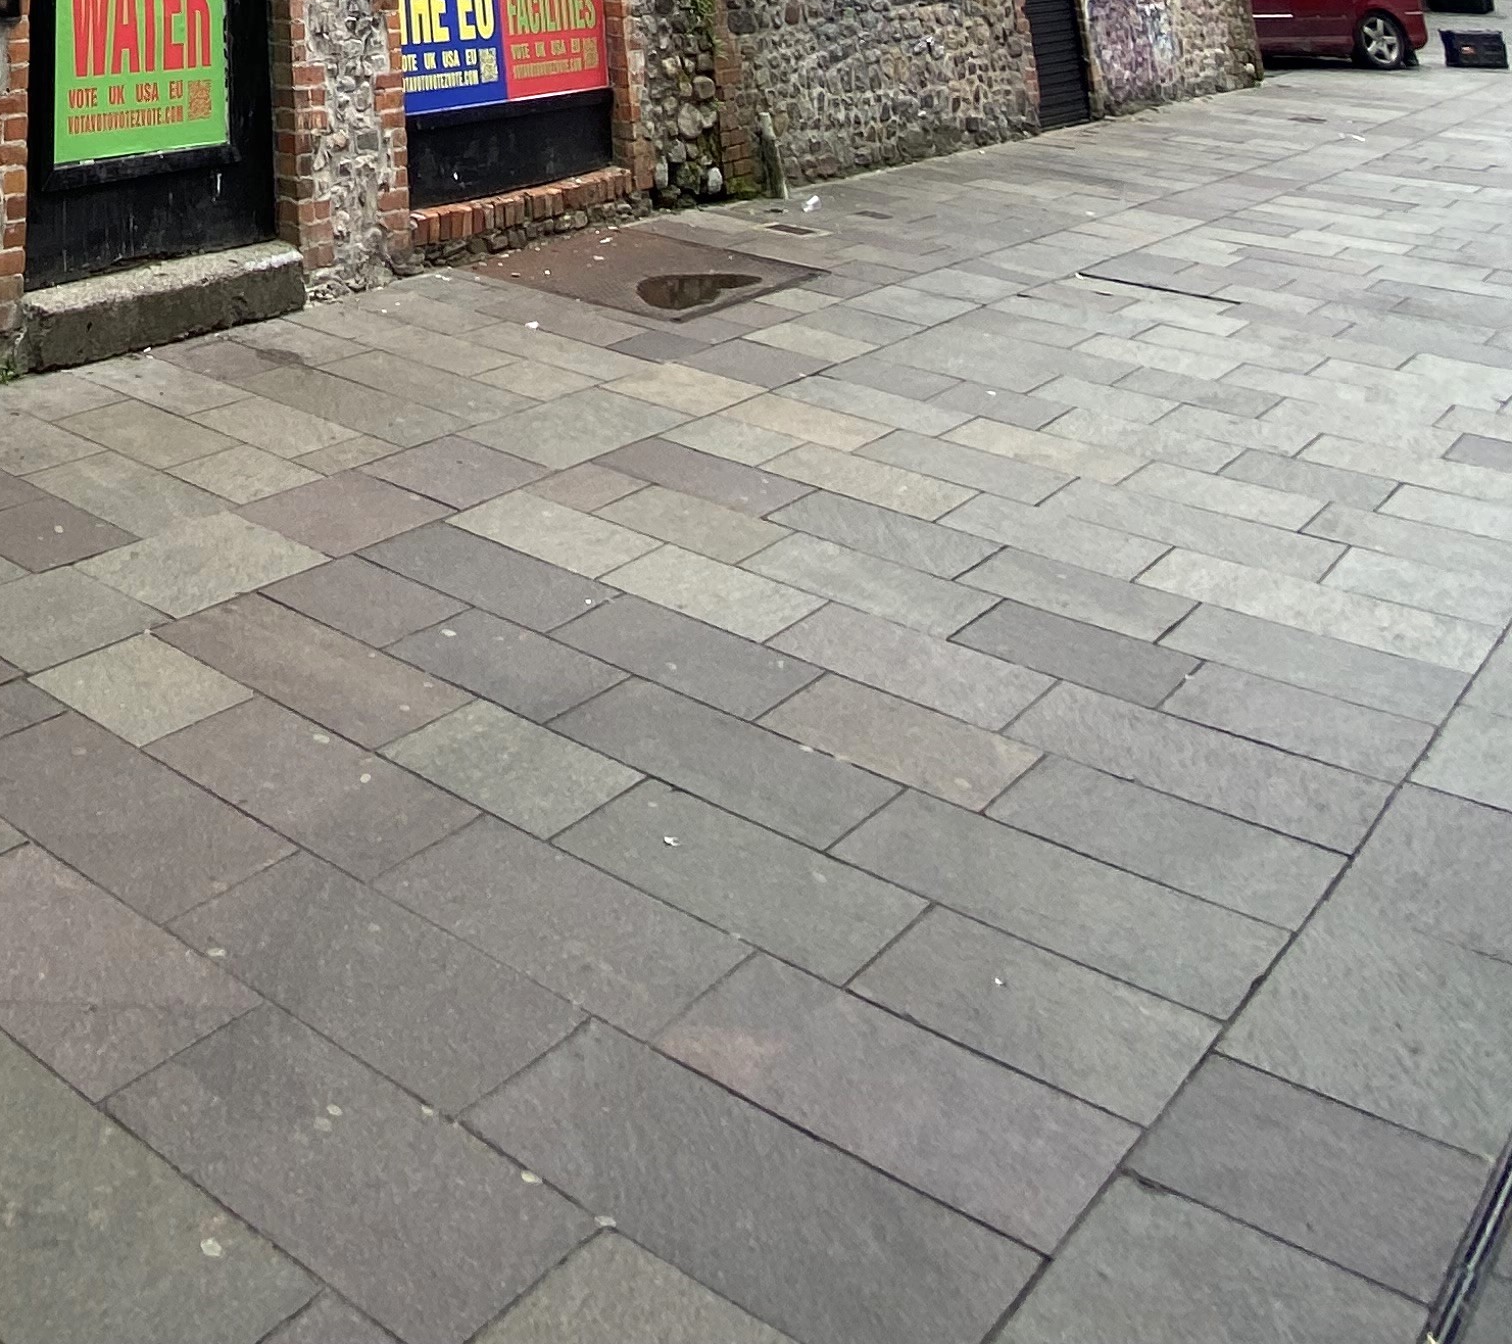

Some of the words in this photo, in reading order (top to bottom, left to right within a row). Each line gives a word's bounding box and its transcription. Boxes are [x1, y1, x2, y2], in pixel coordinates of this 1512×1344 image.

[401, 53, 419, 72] OTE
[69, 87, 98, 109] VOTE
[109, 84, 125, 105] UK
[136, 82, 159, 102] USA
[169, 80, 183, 100] EU
